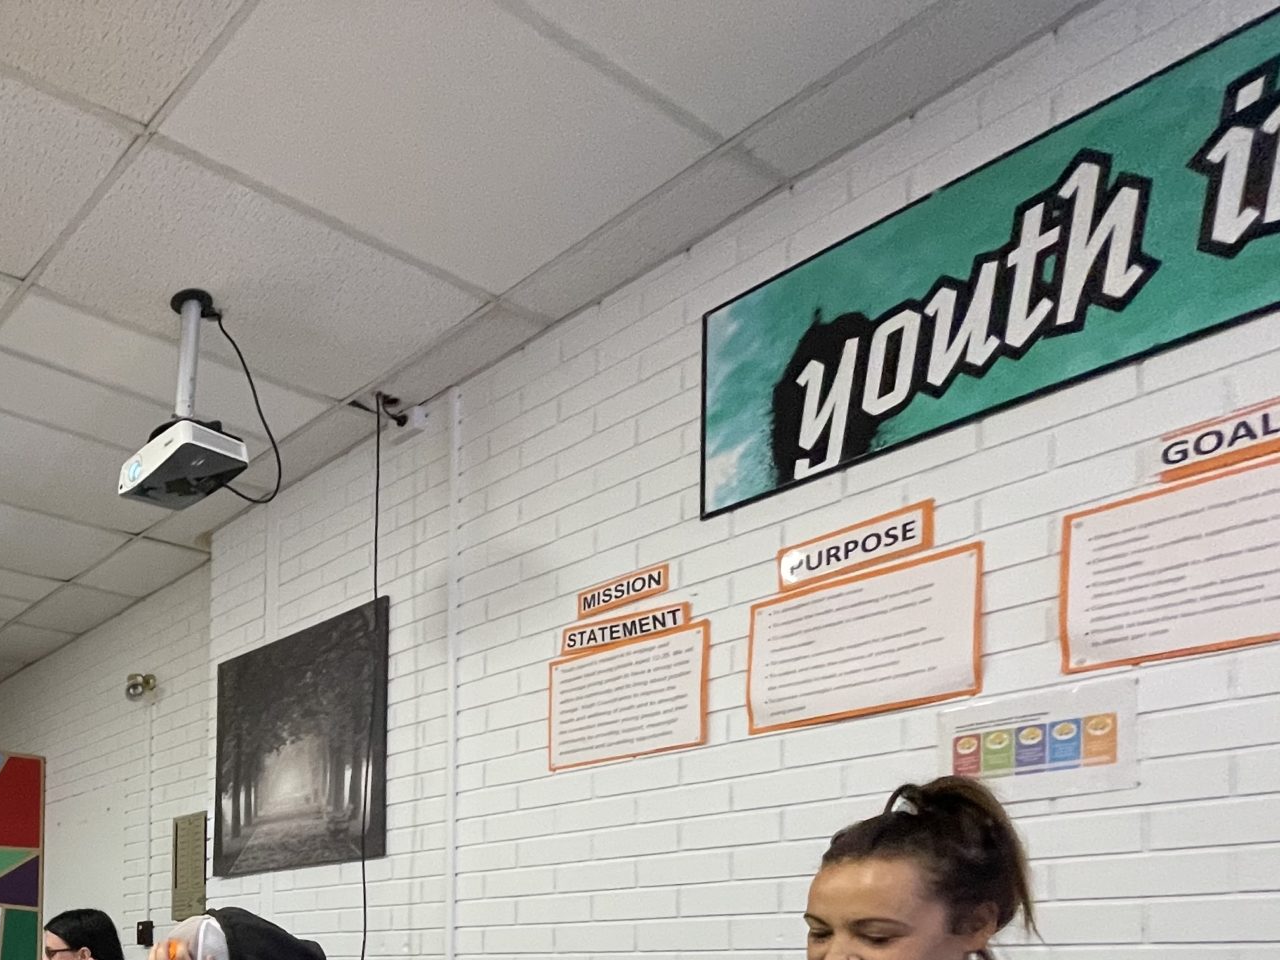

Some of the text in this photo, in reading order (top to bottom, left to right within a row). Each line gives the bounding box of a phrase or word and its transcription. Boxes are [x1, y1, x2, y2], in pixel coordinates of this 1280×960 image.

[794, 70, 1280, 480] youth i
[582, 571, 662, 612] MISSION
[566, 608, 682, 649] STATEMENT
